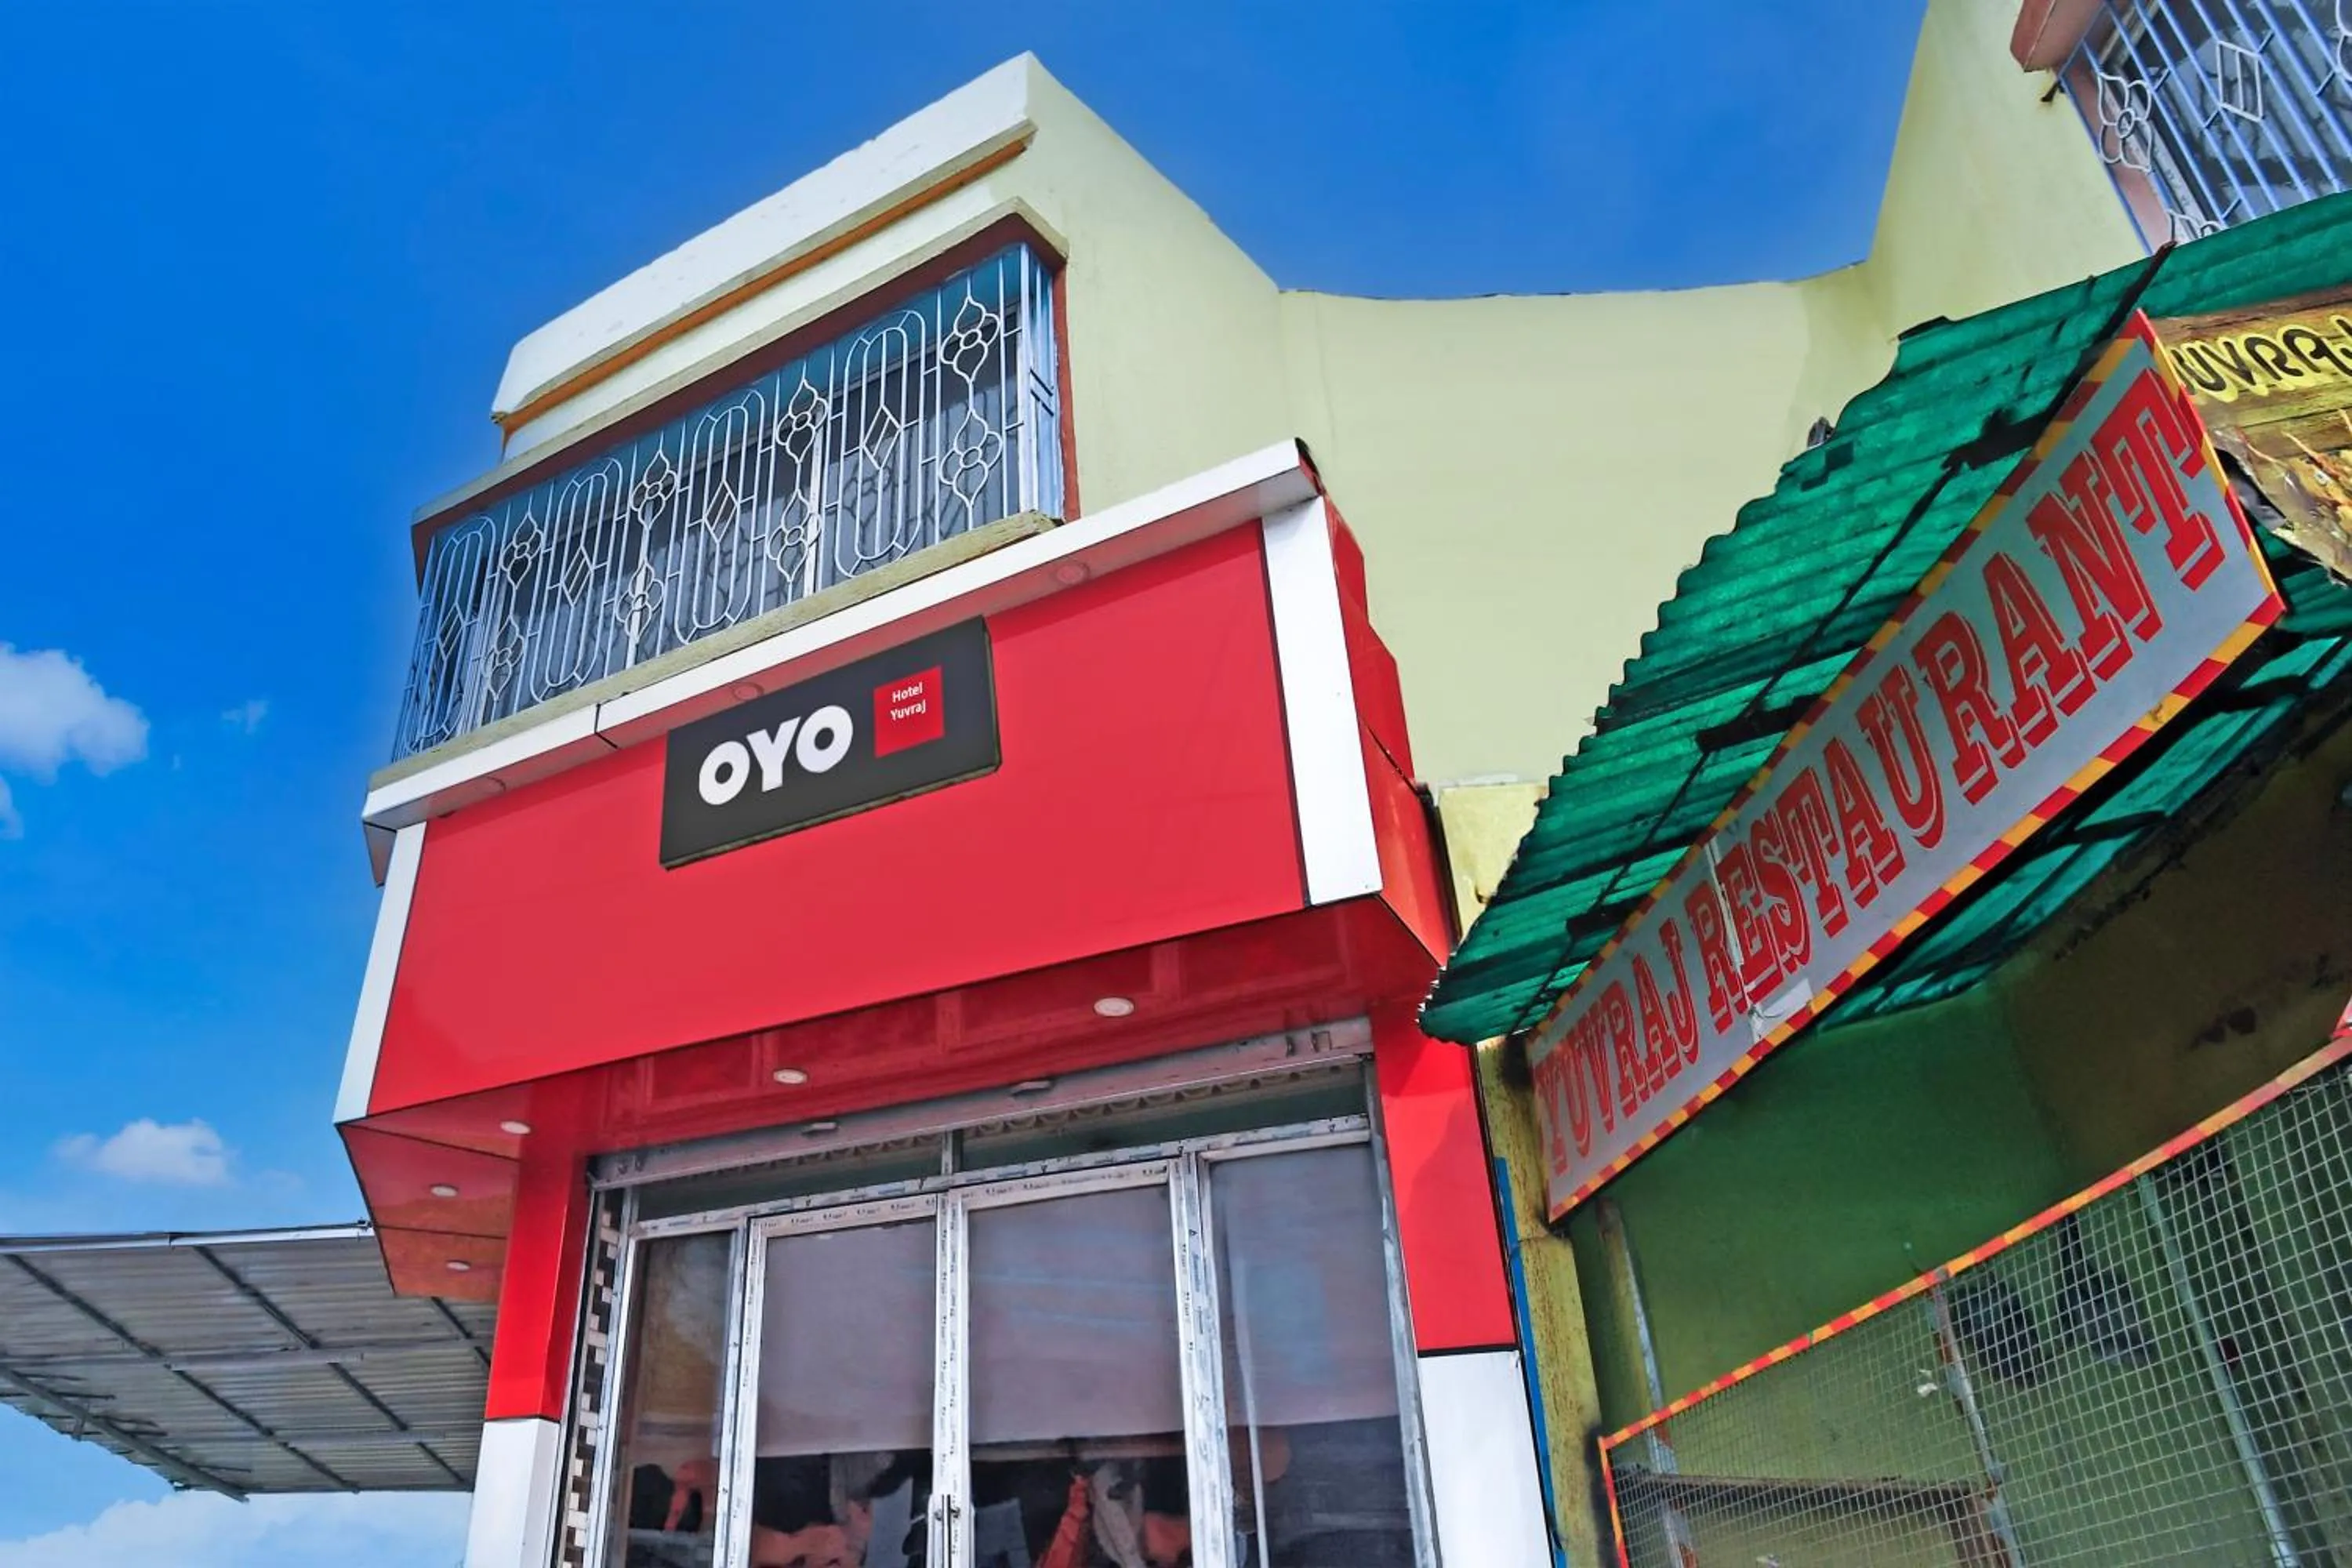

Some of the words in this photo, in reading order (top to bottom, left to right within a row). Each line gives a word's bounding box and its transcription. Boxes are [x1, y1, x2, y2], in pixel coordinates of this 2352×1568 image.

[890, 698, 927, 721] Yuvraj
[891, 681, 924, 704] Hotel
[698, 704, 854, 807] OYO
[1533, 916, 1700, 1176] YUVRAJ
[1683, 366, 2227, 1036] RESTAURANT
